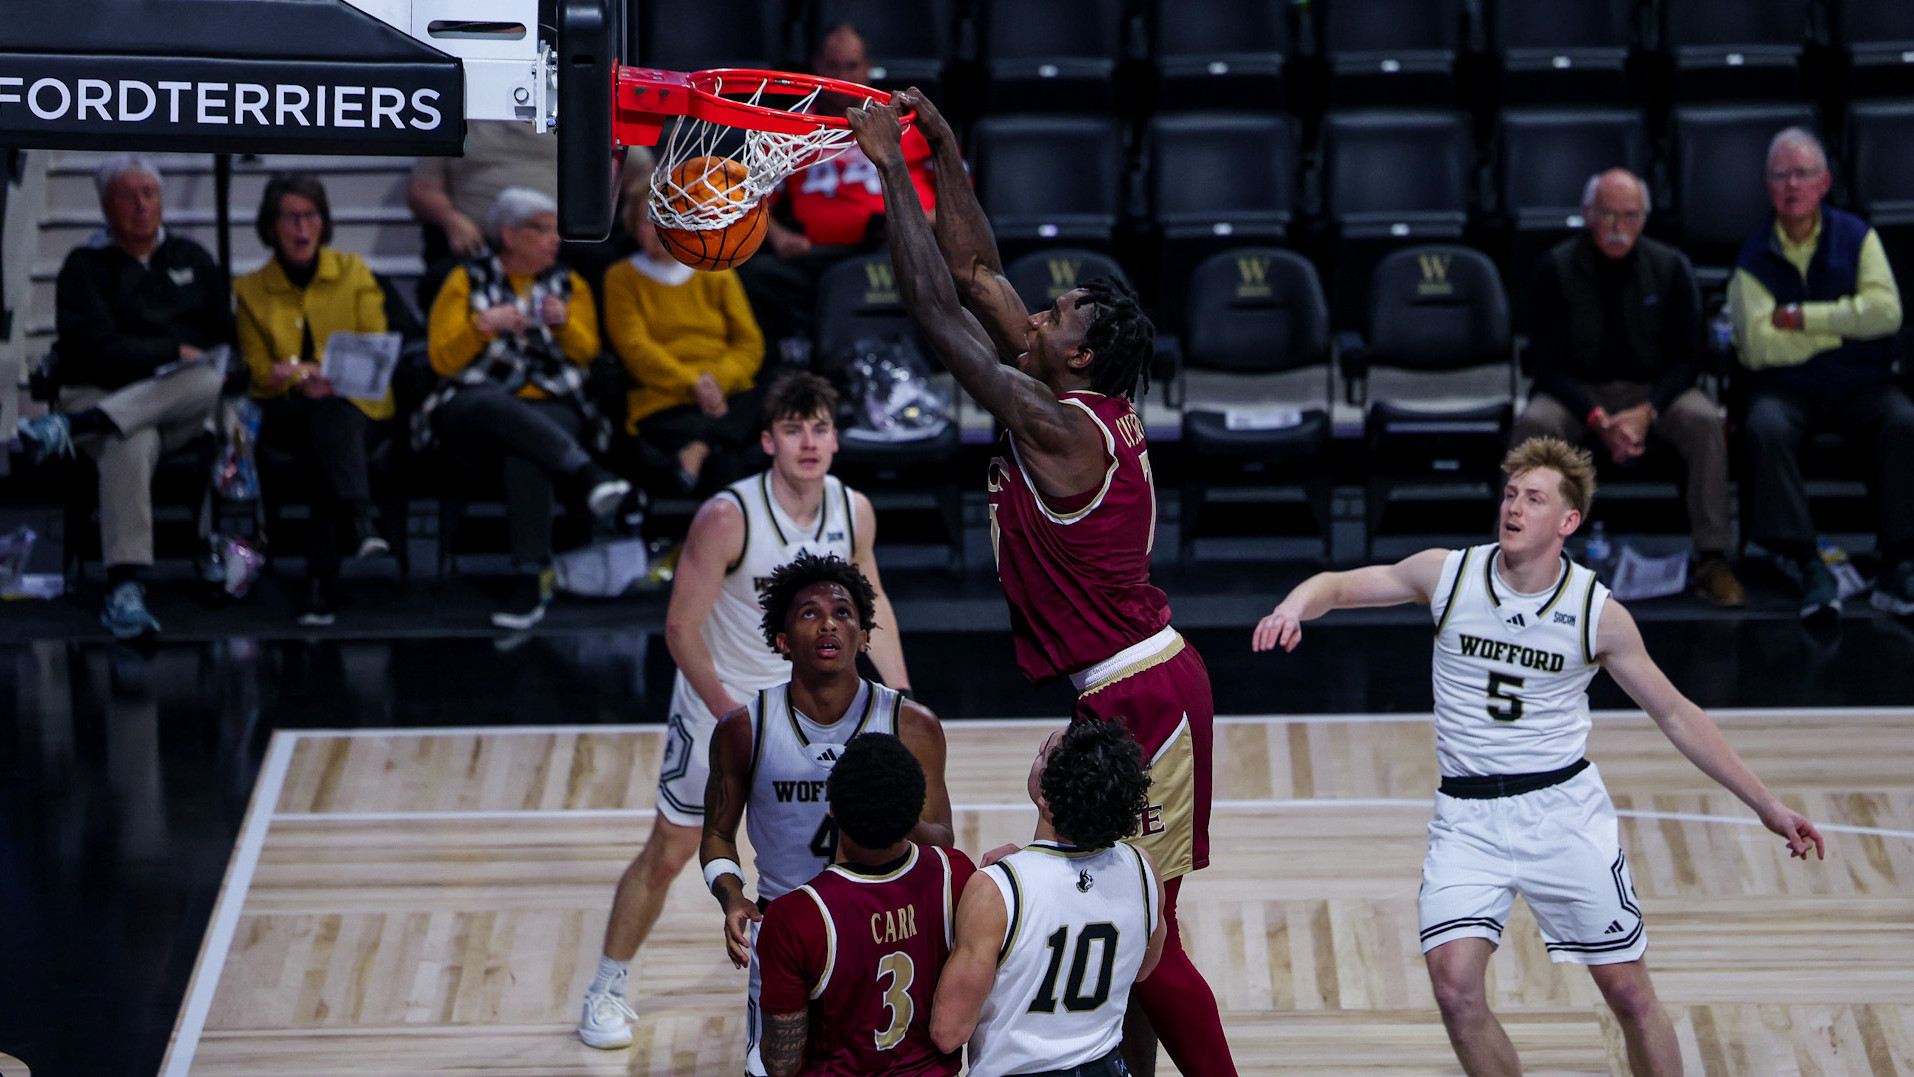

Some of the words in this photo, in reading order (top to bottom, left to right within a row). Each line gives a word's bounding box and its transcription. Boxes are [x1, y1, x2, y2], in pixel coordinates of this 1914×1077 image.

[1459, 633, 1566, 674] WOFFORD
[1486, 670, 1525, 722] 5
[870, 903, 918, 945] CARR
[1026, 920, 1121, 1015] 10
[874, 950, 915, 1051] 3
